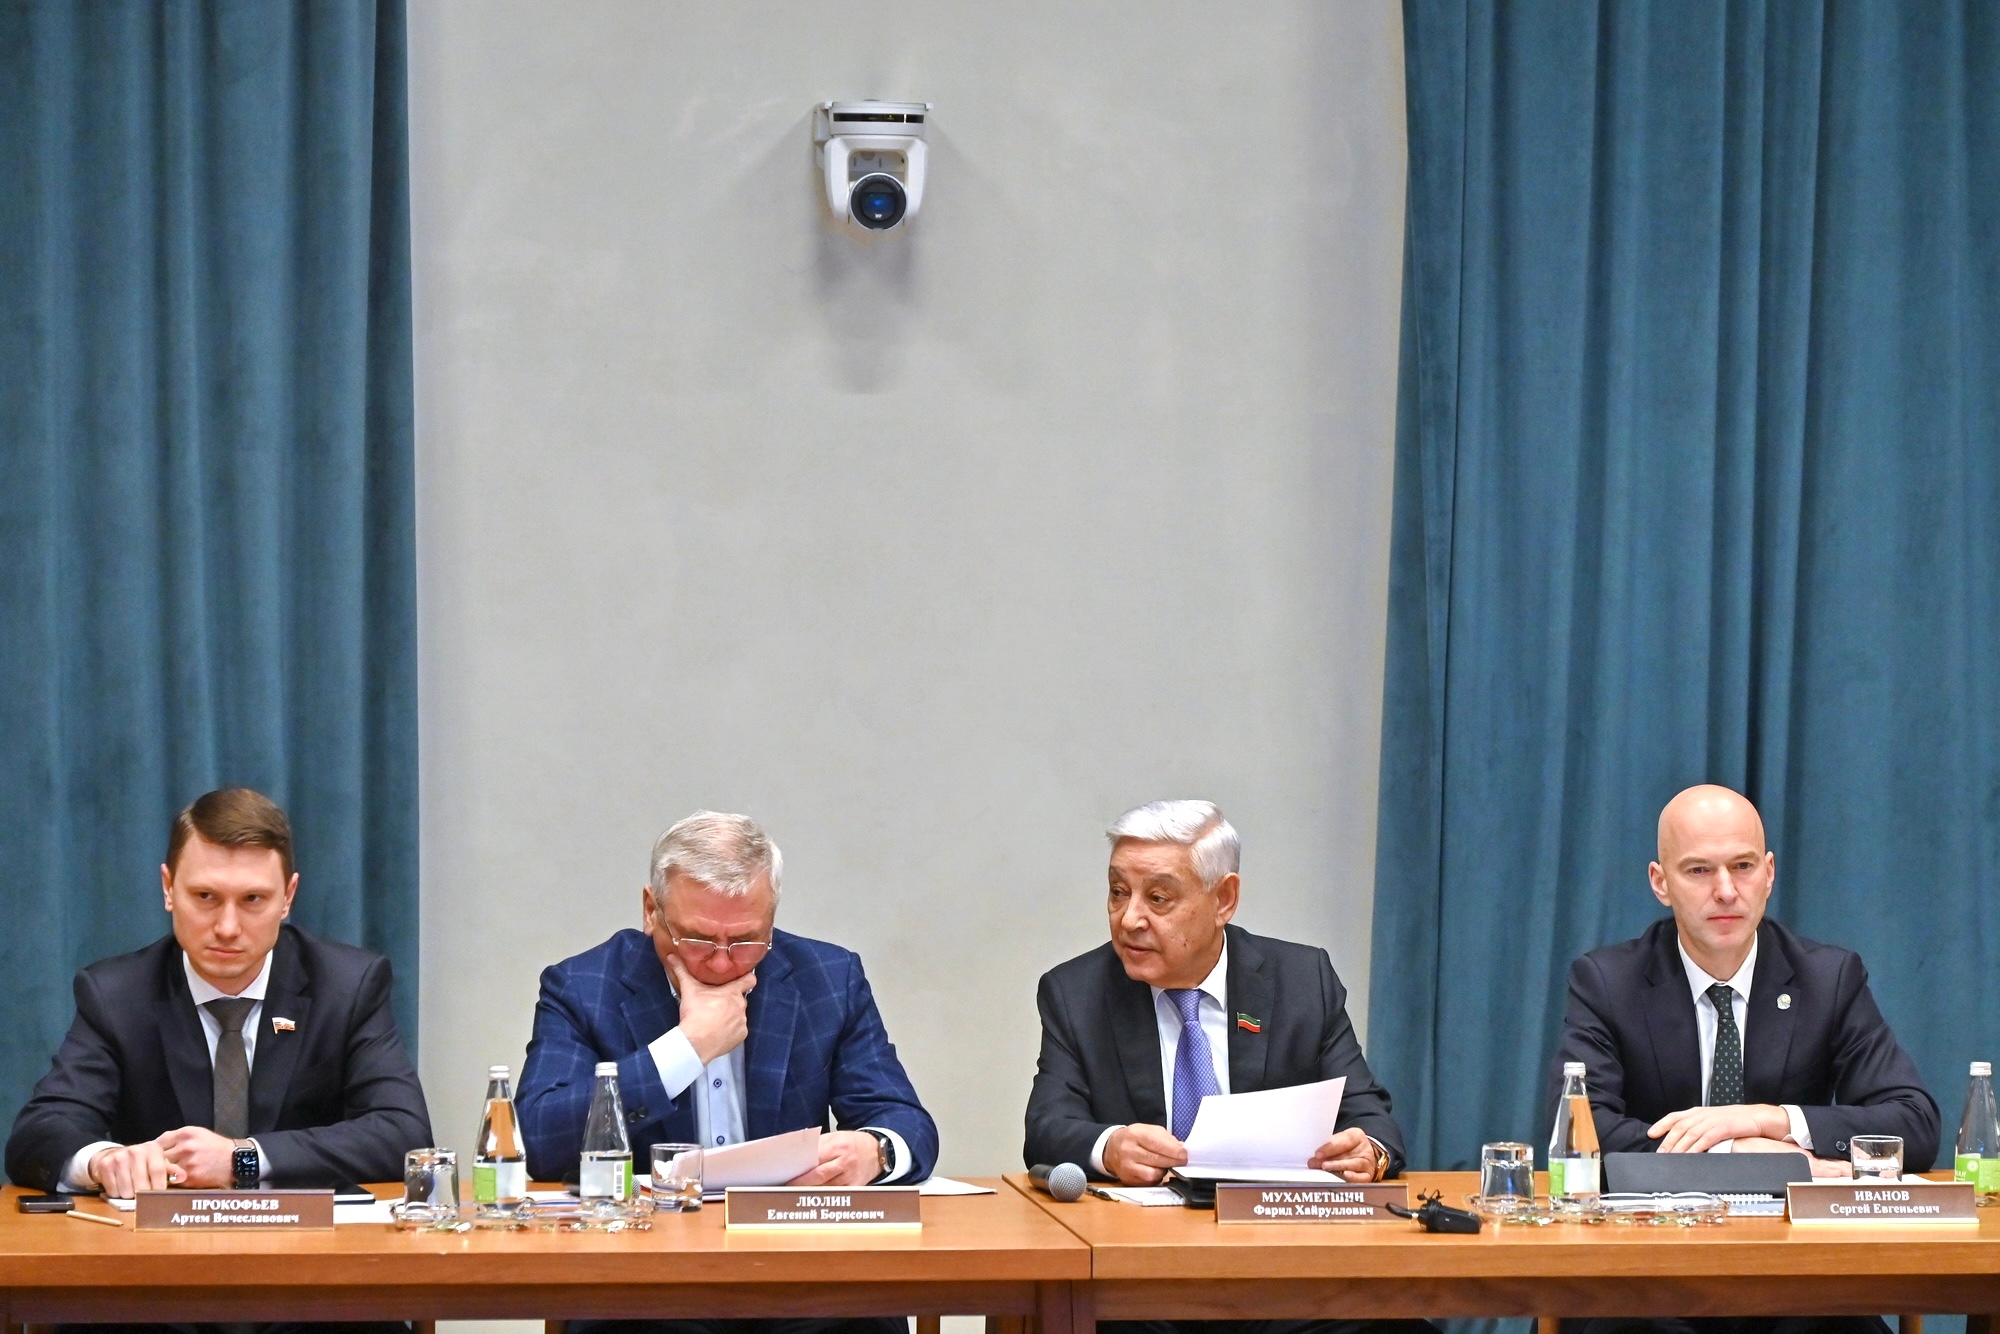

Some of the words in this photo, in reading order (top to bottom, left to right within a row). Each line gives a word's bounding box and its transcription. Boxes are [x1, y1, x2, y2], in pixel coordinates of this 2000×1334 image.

[795, 1196, 851, 1207] ЛЮЛИН
[1261, 1191, 1365, 1203] МУХАМЕТШИН
[1854, 1190, 1911, 1201] ИВАНОВ
[191, 1199, 280, 1211] ПРОКОФЬЕВ
[1253, 1204, 1293, 1217] Фарид
[1294, 1204, 1375, 1217] Хайруллович
[1829, 1203, 1871, 1216] Сергей
[1873, 1203, 1940, 1214] Евгеньевич
[170, 1212, 211, 1225] Артем
[213, 1212, 300, 1224] Вячеславович
[767, 1208, 818, 1220] Евгений
[820, 1208, 885, 1221] Борисович
